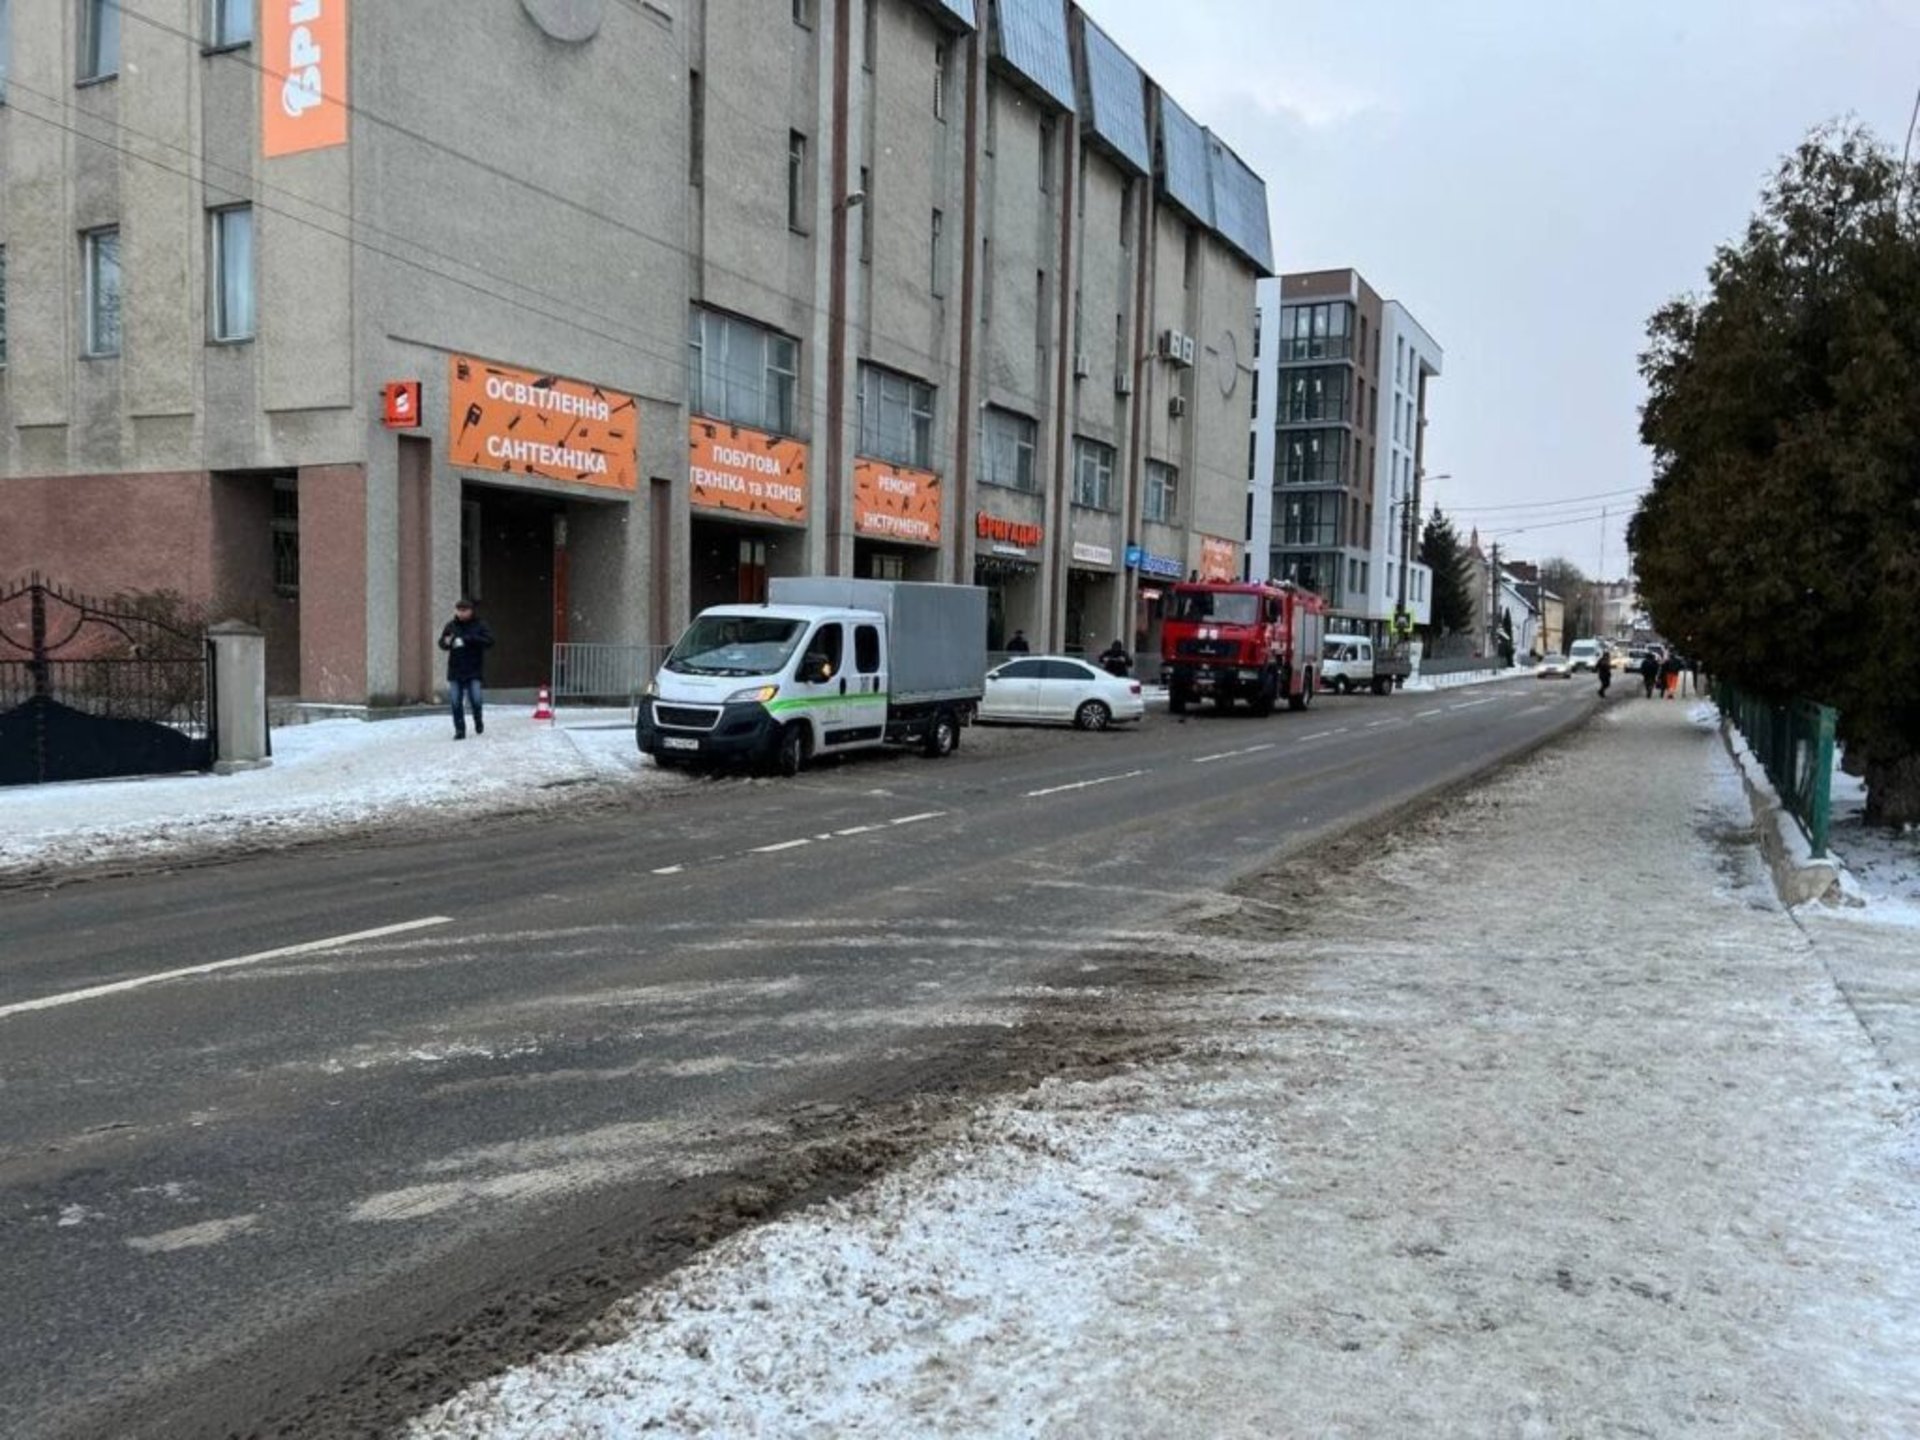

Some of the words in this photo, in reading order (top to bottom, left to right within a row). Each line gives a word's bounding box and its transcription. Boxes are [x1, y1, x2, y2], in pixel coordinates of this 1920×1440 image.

[485, 376, 610, 421] ОСВІТЛЕННЯ
[486, 435, 607, 473] САНТЕХНІКА
[713, 445, 781, 476] ПОБУТОВА
[765, 481, 802, 503] ХІМІЯ
